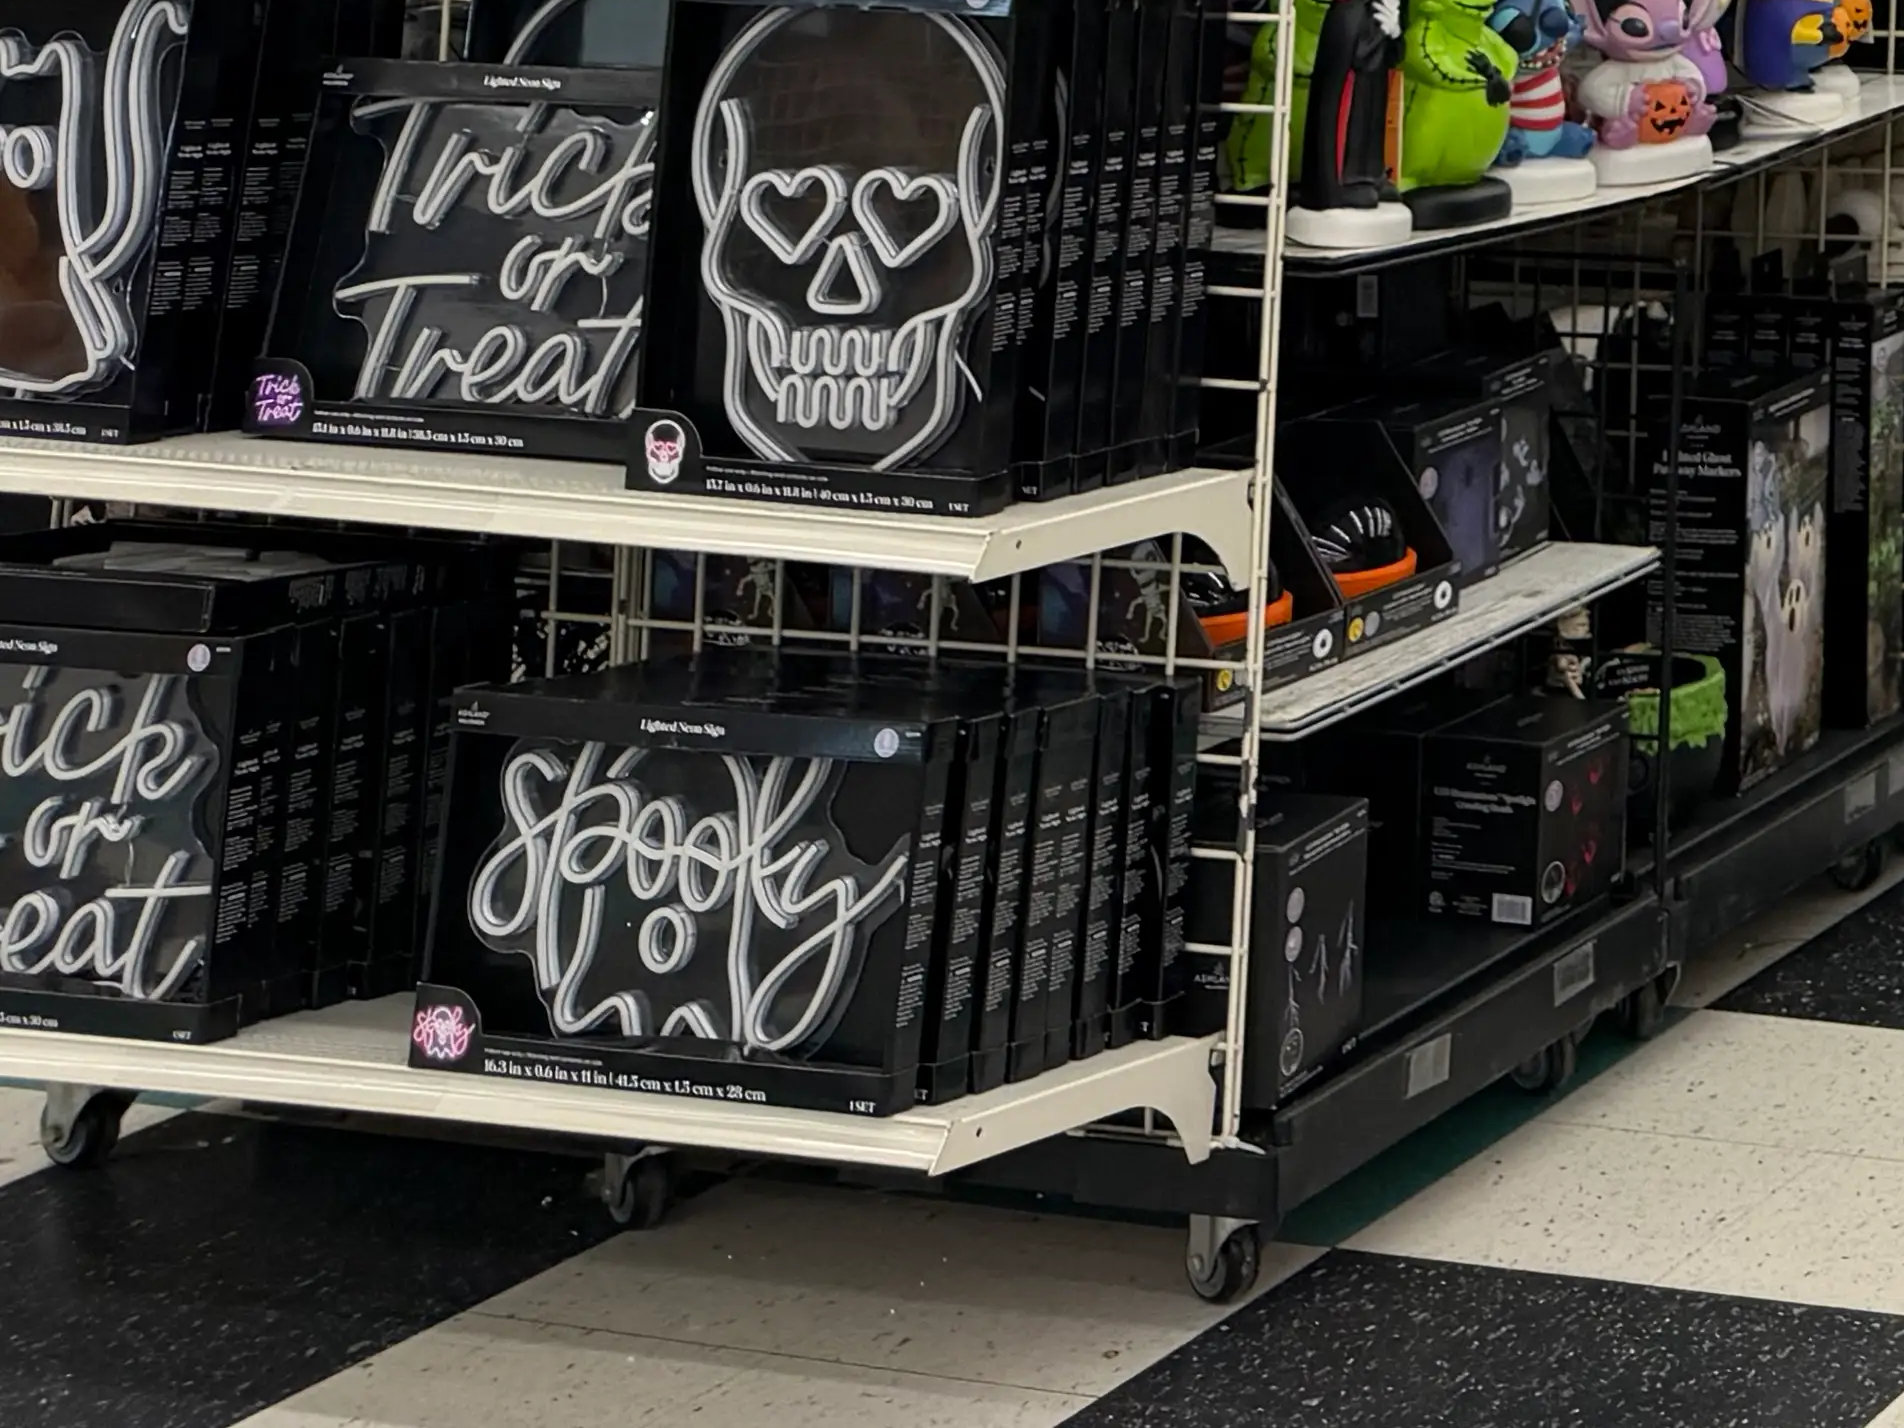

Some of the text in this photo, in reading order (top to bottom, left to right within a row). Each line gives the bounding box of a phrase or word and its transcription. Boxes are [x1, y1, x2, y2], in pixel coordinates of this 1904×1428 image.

[484, 75, 518, 88] Lighted
[353, 96, 654, 238] Trick
[500, 234, 624, 312] or
[335, 274, 643, 415] Treat
[255, 399, 304, 422] Treat
[256, 374, 301, 396] Trick
[0, 665, 206, 804] ick
[641, 719, 725, 737] Lighted Neon Sign
[24, 796, 145, 879] or
[0, 851, 211, 1000] eat
[484, 1059, 506, 1075] 16.3
[508, 1062, 520, 1075] in
[534, 1063, 552, 1078] 0.6
[554, 1067, 567, 1080] in
[593, 1071, 607, 1084] in
[640, 1078, 660, 1090] cm
[691, 1082, 712, 1095] cm
[744, 1087, 766, 1101] cm
[855, 1101, 875, 1114] SET
